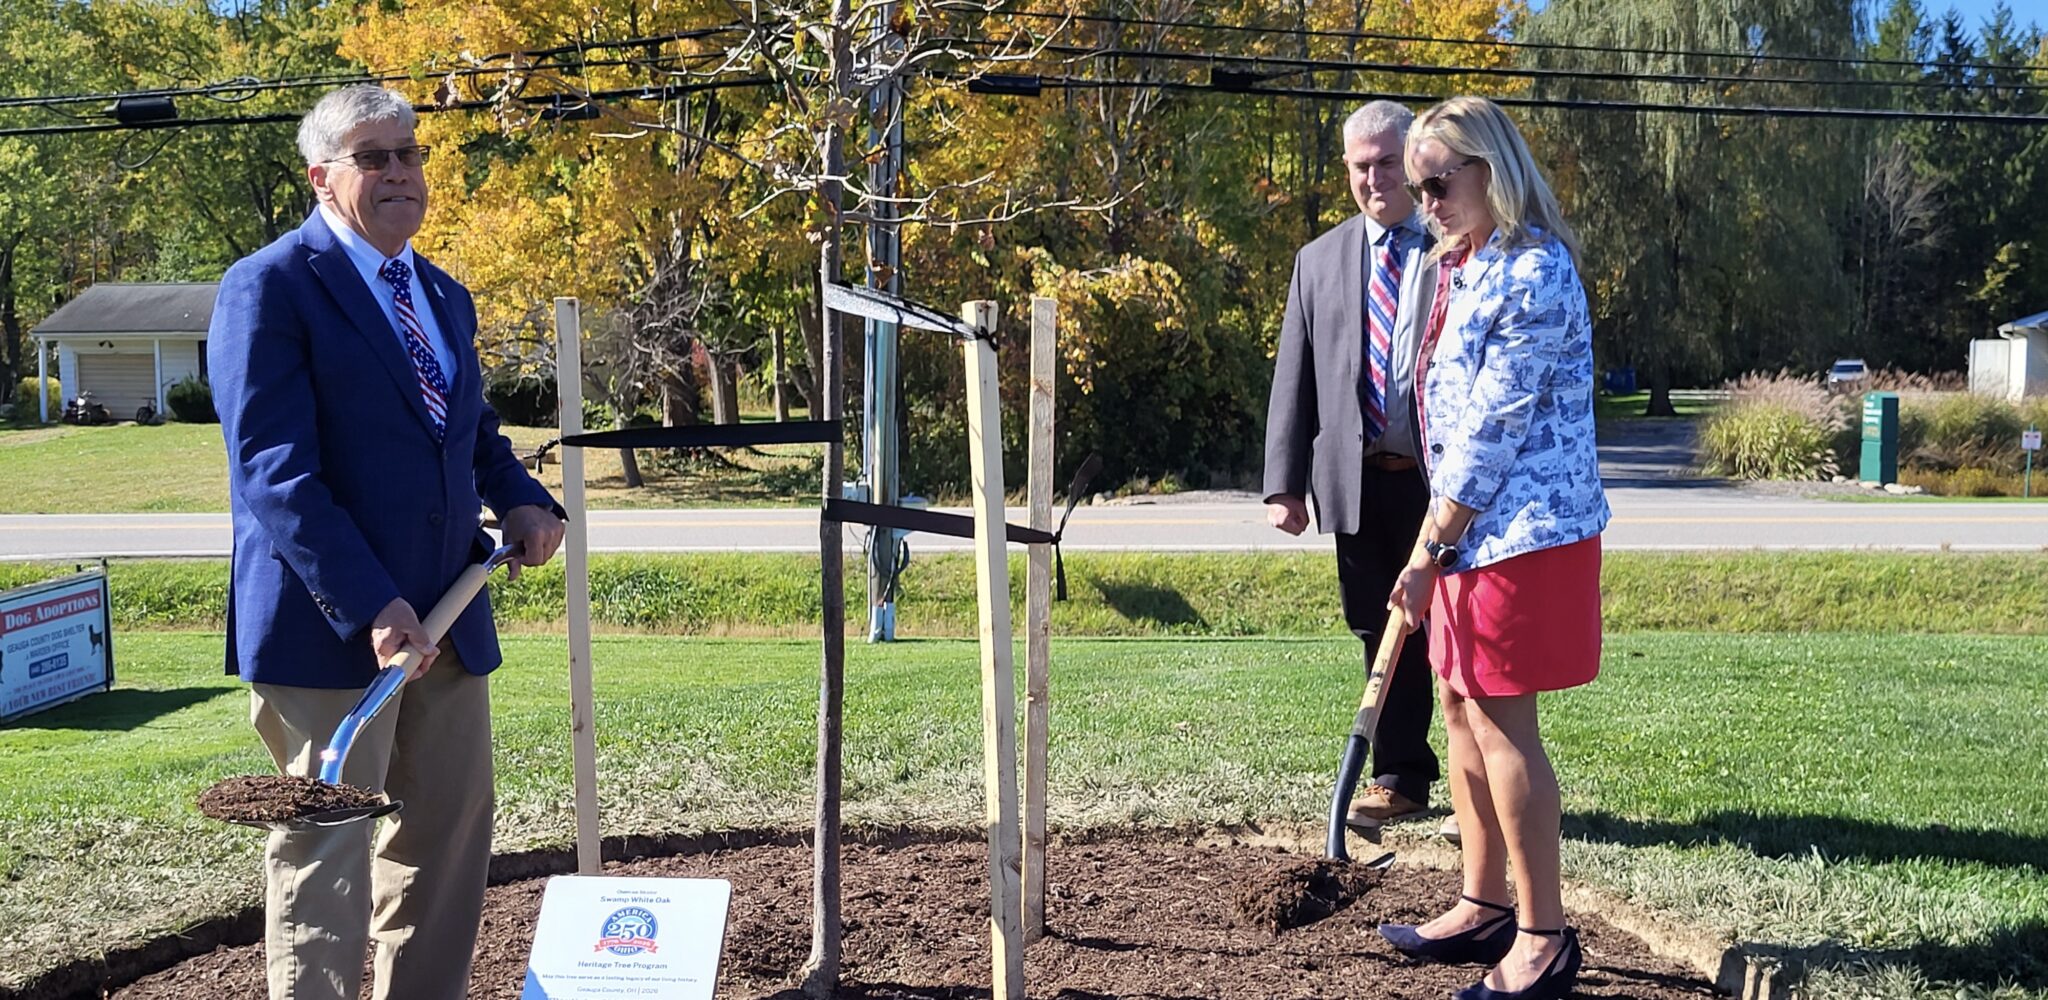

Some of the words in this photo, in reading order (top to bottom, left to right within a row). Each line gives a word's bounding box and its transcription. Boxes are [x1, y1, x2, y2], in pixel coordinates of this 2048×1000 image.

[5, 612, 31, 630] DOG
[35, 596, 98, 621] ADOPTIONS
[30, 633, 50, 646] COUNTY
[51, 629, 63, 641] DOG
[63, 624, 85, 637] SHELTER
[52, 640, 71, 652] OFFICE
[600, 896, 630, 904] Swamp
[612, 908, 653, 924] AMERICA
[607, 923, 653, 941] 250
[577, 961, 612, 969] Heritage
[633, 962, 668, 970] Program
